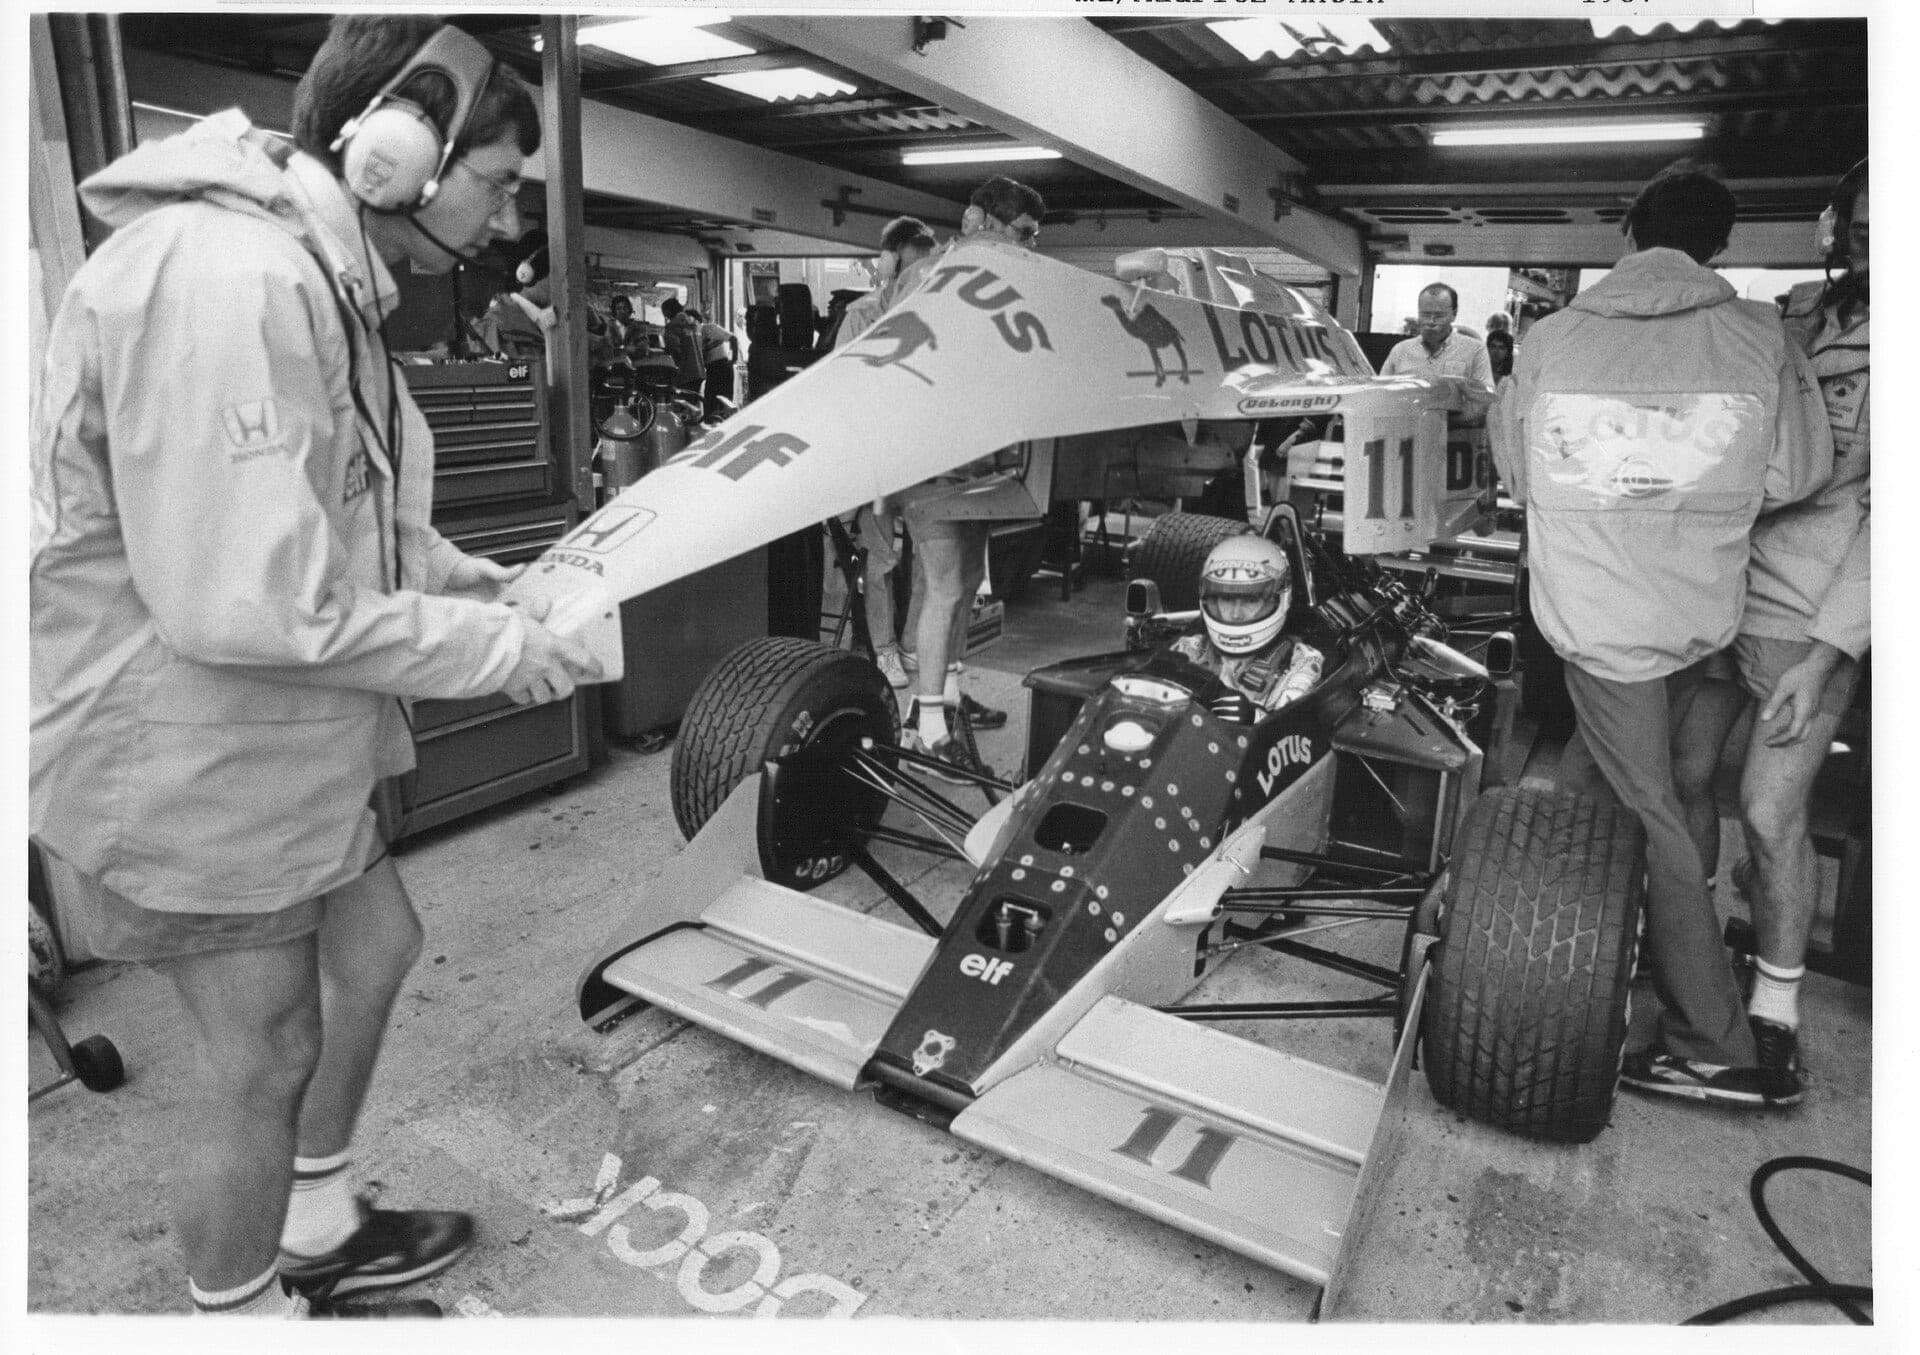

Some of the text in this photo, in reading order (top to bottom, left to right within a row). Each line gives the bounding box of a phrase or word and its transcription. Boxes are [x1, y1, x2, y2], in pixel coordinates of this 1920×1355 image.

[922, 265, 1055, 353] TUS
[1202, 303, 1346, 376] LOTUS
[509, 365, 528, 378] elf
[1364, 438, 1414, 520] 11
[1256, 735, 1312, 797] LOTUS
[703, 956, 815, 1011] 11
[960, 953, 1014, 985] elf
[1111, 1106, 1240, 1190] 11
